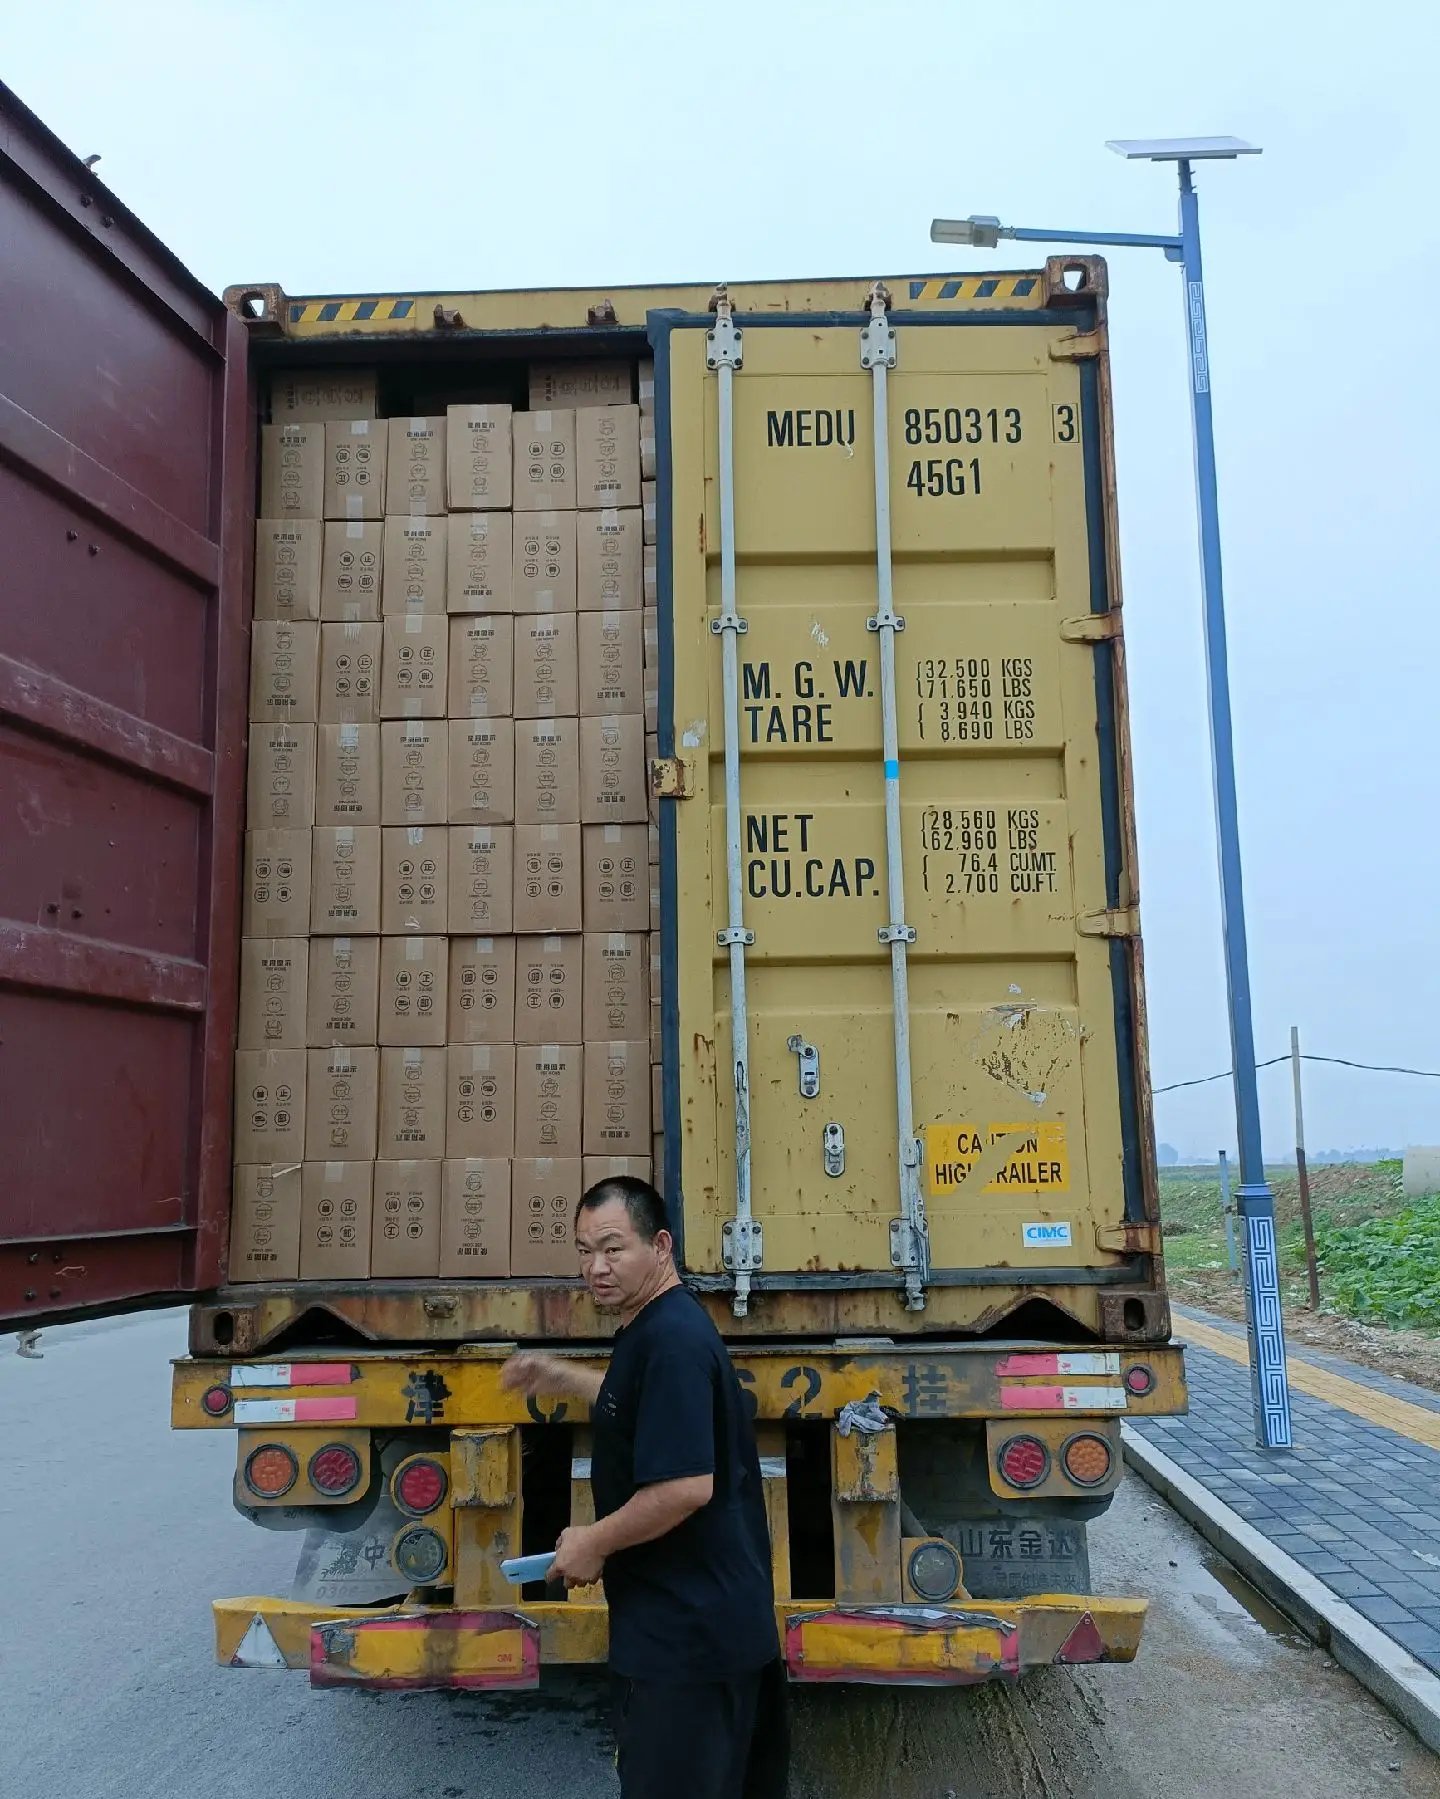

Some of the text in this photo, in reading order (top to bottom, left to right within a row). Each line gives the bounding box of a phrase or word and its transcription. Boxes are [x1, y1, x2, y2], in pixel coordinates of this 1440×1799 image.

[767, 405, 1075, 447] MEDU 850313 3
[906, 457, 982, 497] 45G1
[1001, 658, 1033, 678] KGS
[1003, 678, 1032, 698] LBS
[1004, 699, 1035, 719] KGS
[744, 703, 834, 743] TARE
[1005, 720, 1034, 739] LBS
[1007, 809, 1040, 829] KGS
[746, 814, 814, 853] NET
[1009, 830, 1037, 850] LBS
[958, 853, 998, 873] 76.4
[748, 858, 880, 899] CU.CAP.
[935, 1161, 1063, 1185] HIG RAILER
[1026, 1226, 1068, 1239] CIMC
